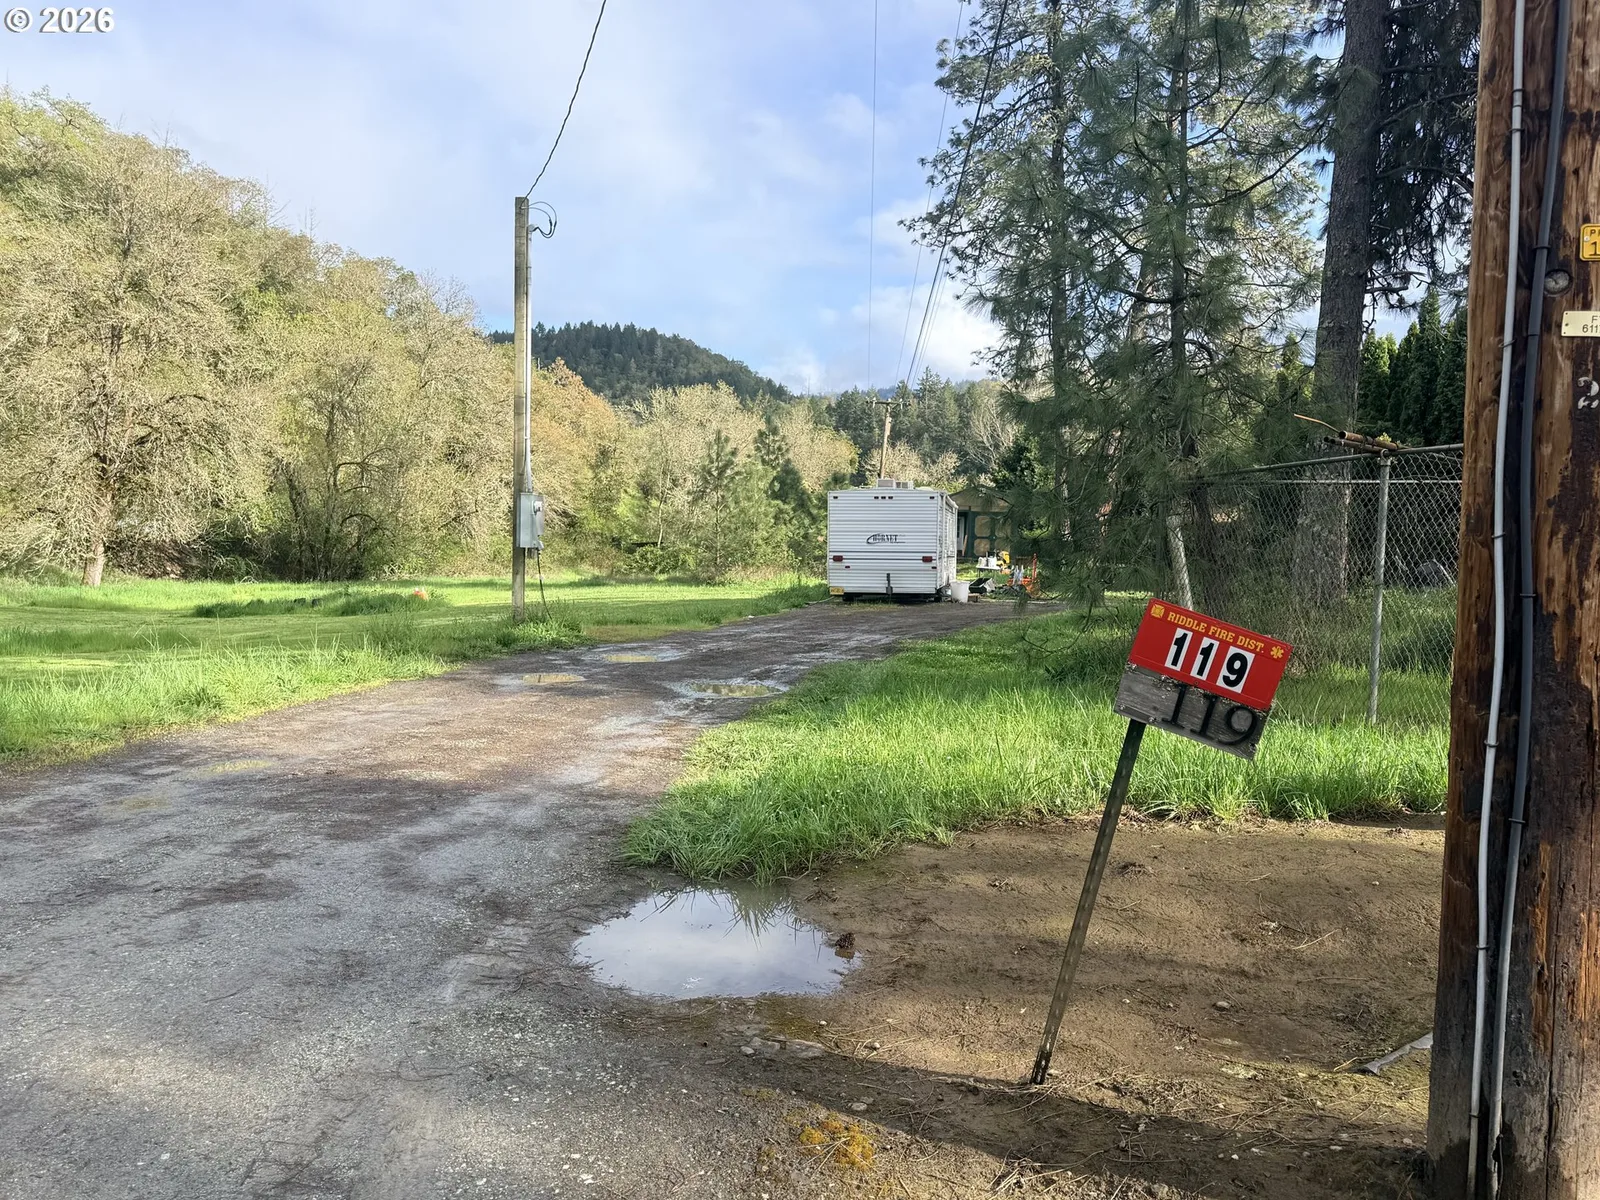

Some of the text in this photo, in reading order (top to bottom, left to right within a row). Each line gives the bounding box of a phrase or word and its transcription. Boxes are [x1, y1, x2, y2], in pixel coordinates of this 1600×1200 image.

[1590, 228, 1600, 237] P
[1582, 324, 1600, 333] 611
[872, 533, 899, 542] HORNET
[1167, 611, 1264, 654] RIDDLE FIRE DIST.
[1170, 632, 1249, 688] 119
[1161, 684, 1258, 746] 119
